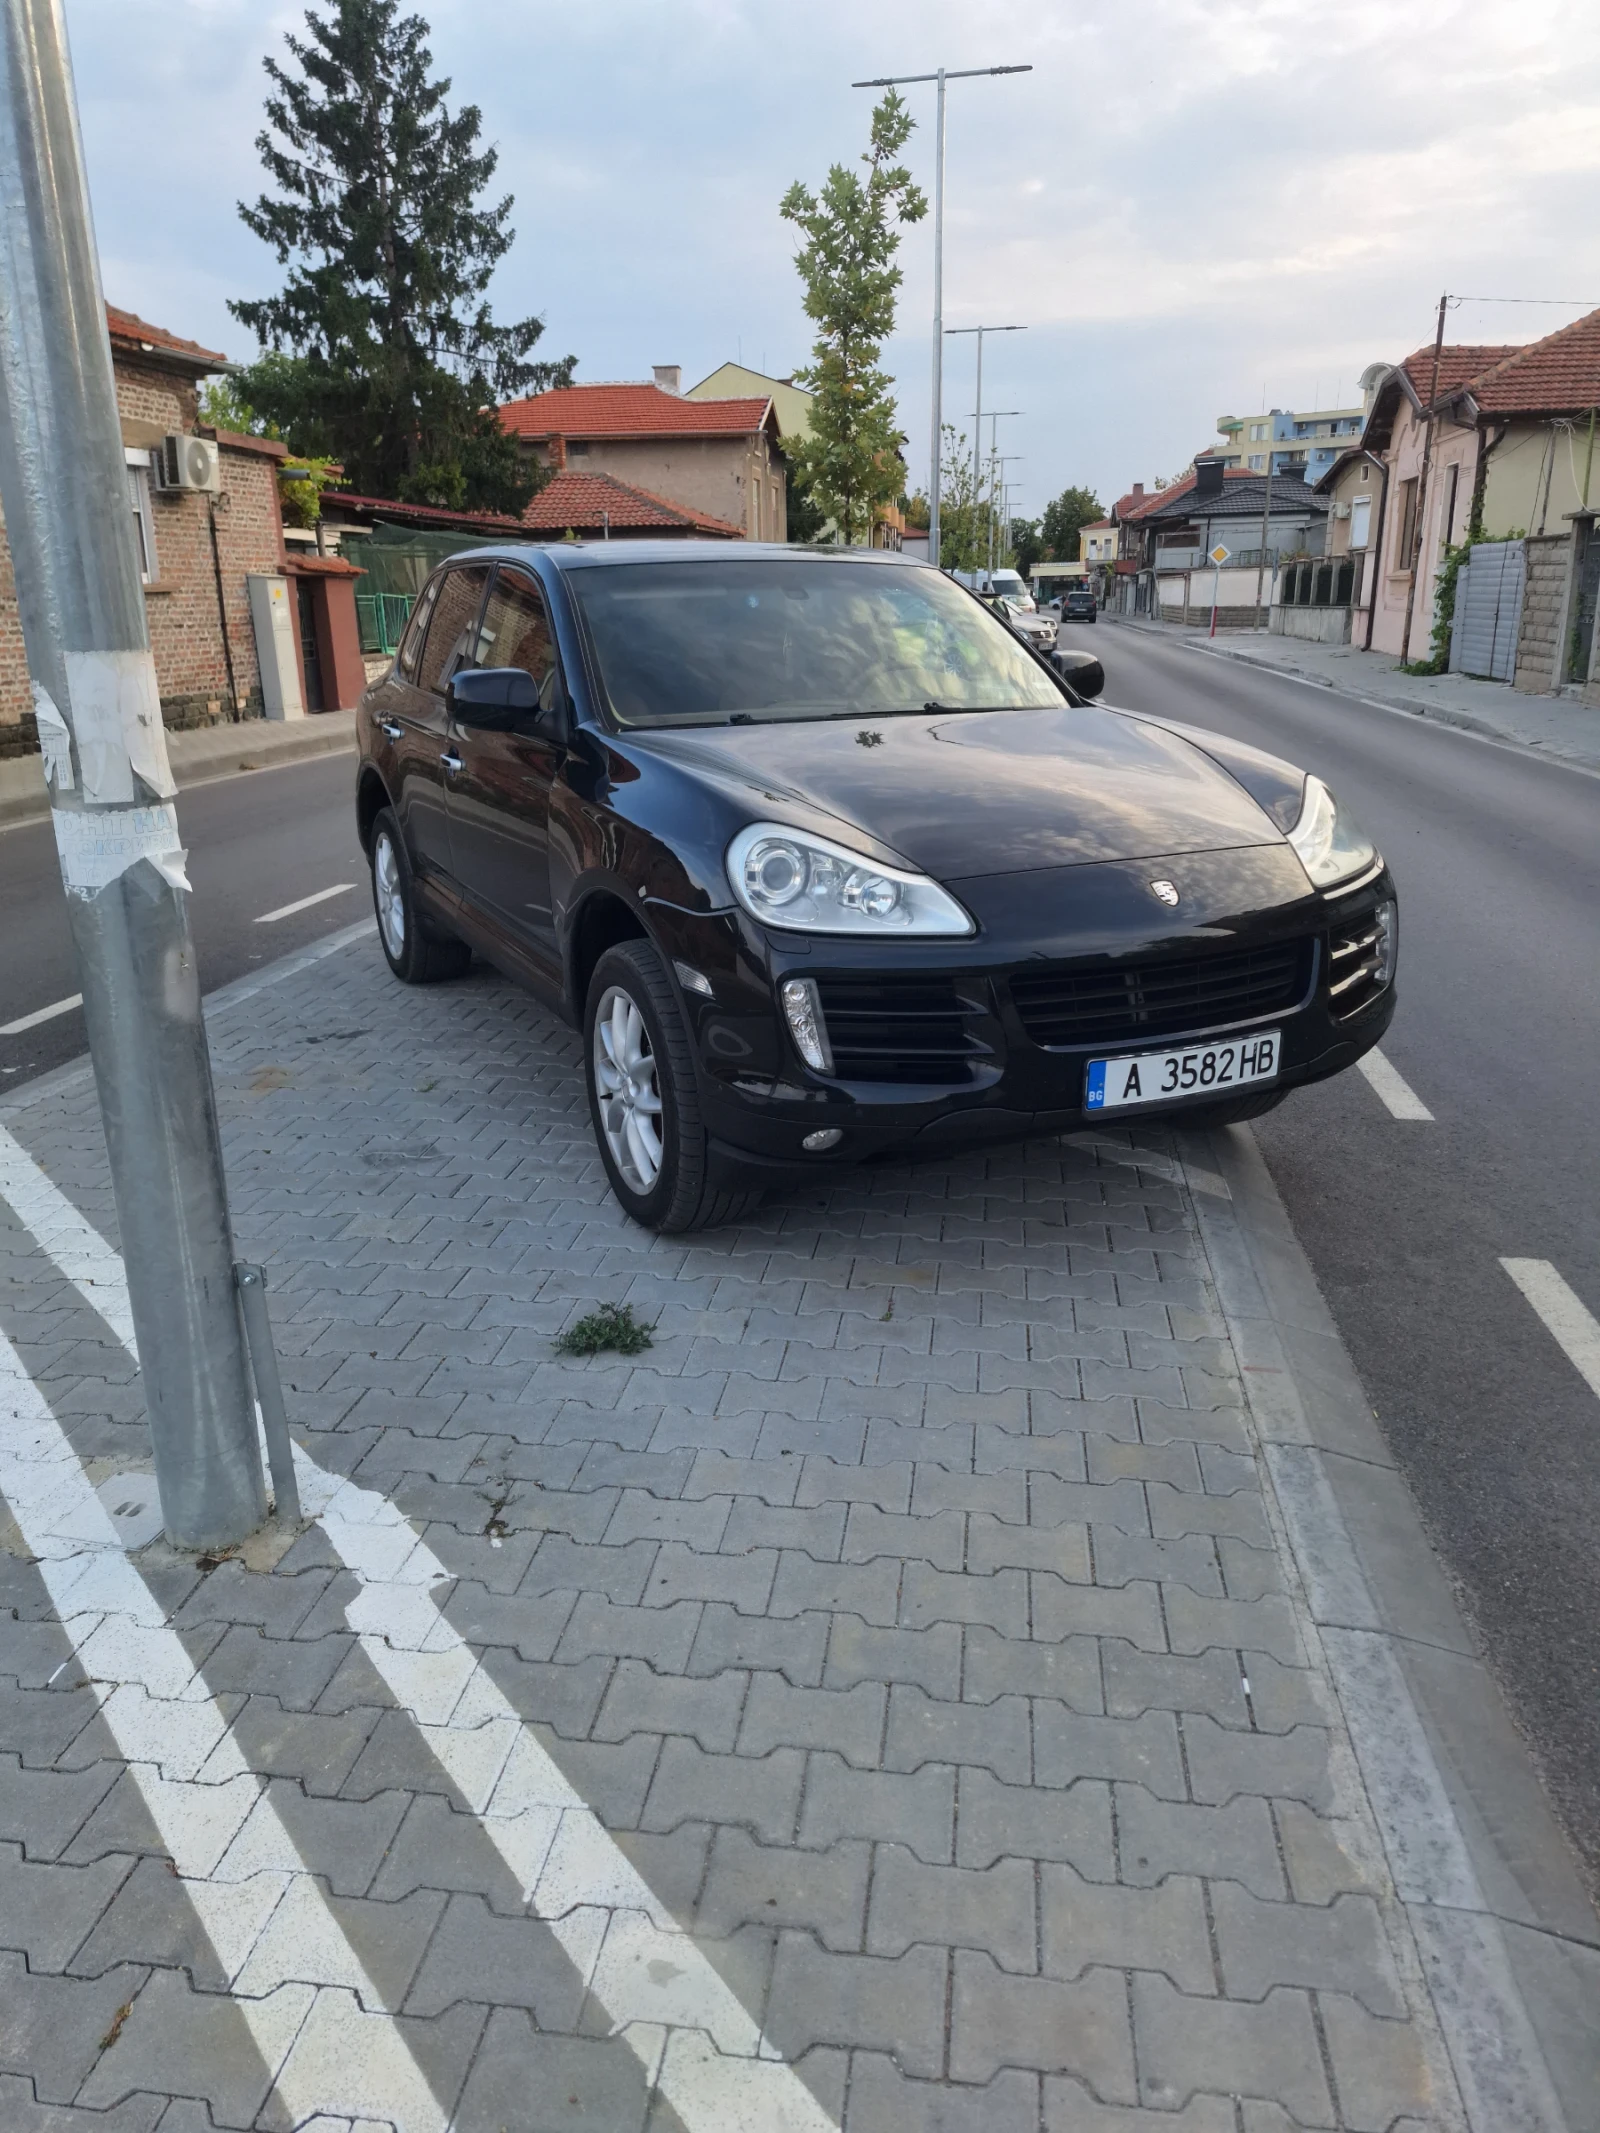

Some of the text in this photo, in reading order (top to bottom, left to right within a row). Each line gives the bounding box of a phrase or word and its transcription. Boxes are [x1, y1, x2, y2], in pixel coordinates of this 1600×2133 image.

[132, 809, 172, 834] НА
[1122, 1063, 1142, 1099] A
[1088, 1090, 1103, 1101] BG
